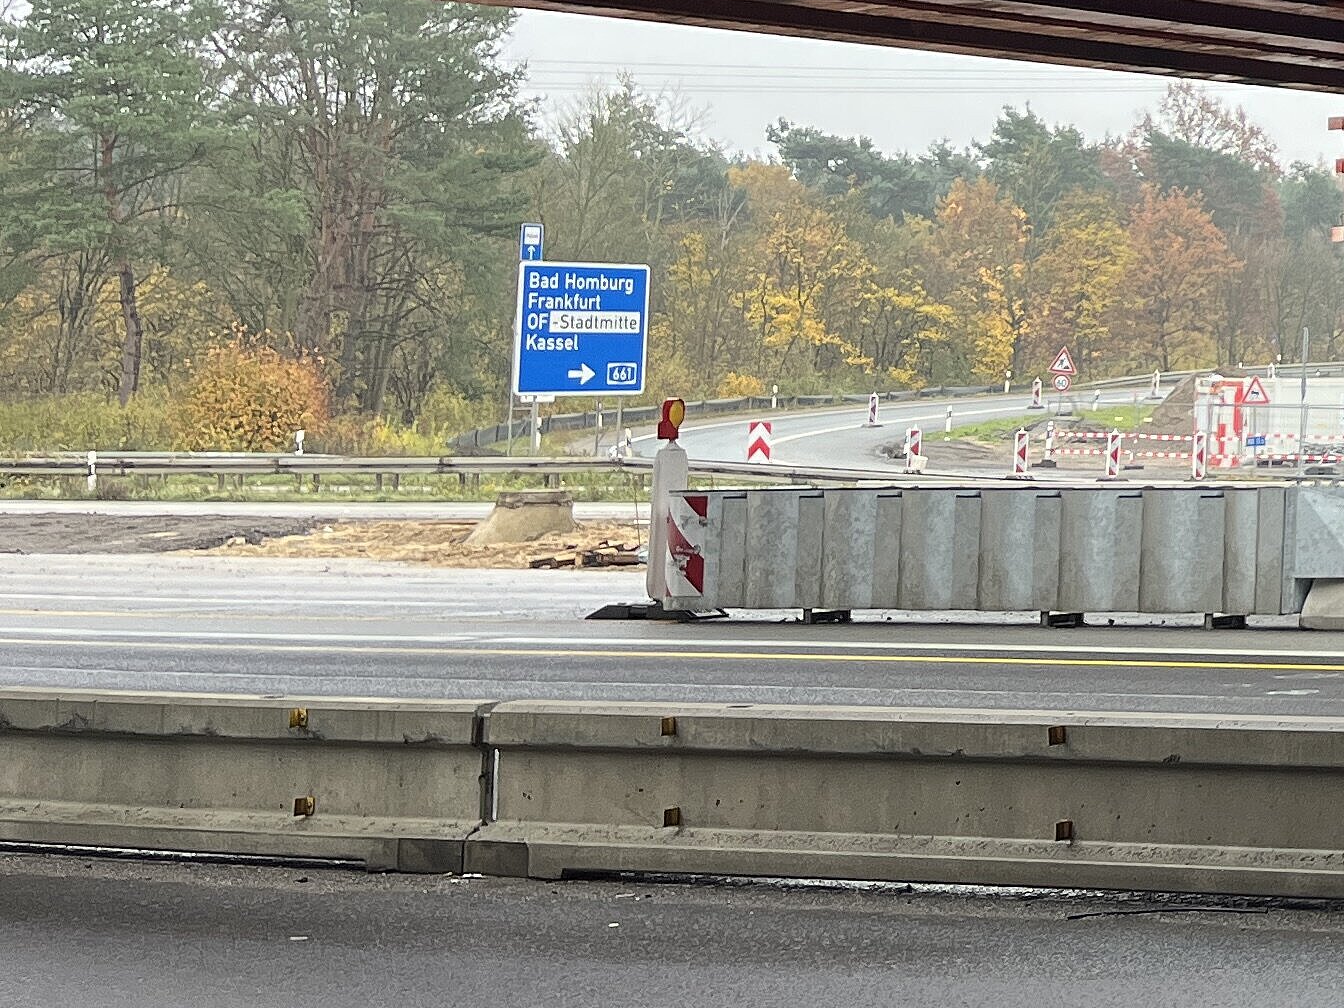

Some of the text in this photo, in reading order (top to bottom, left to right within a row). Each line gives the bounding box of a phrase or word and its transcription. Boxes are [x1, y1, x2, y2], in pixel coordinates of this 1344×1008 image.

[529, 271, 634, 295] Bad Homburg
[528, 292, 601, 310] Frankfurt
[527, 313, 548, 330] OF
[526, 334, 579, 351] Kassel
[612, 368, 632, 382] 661
